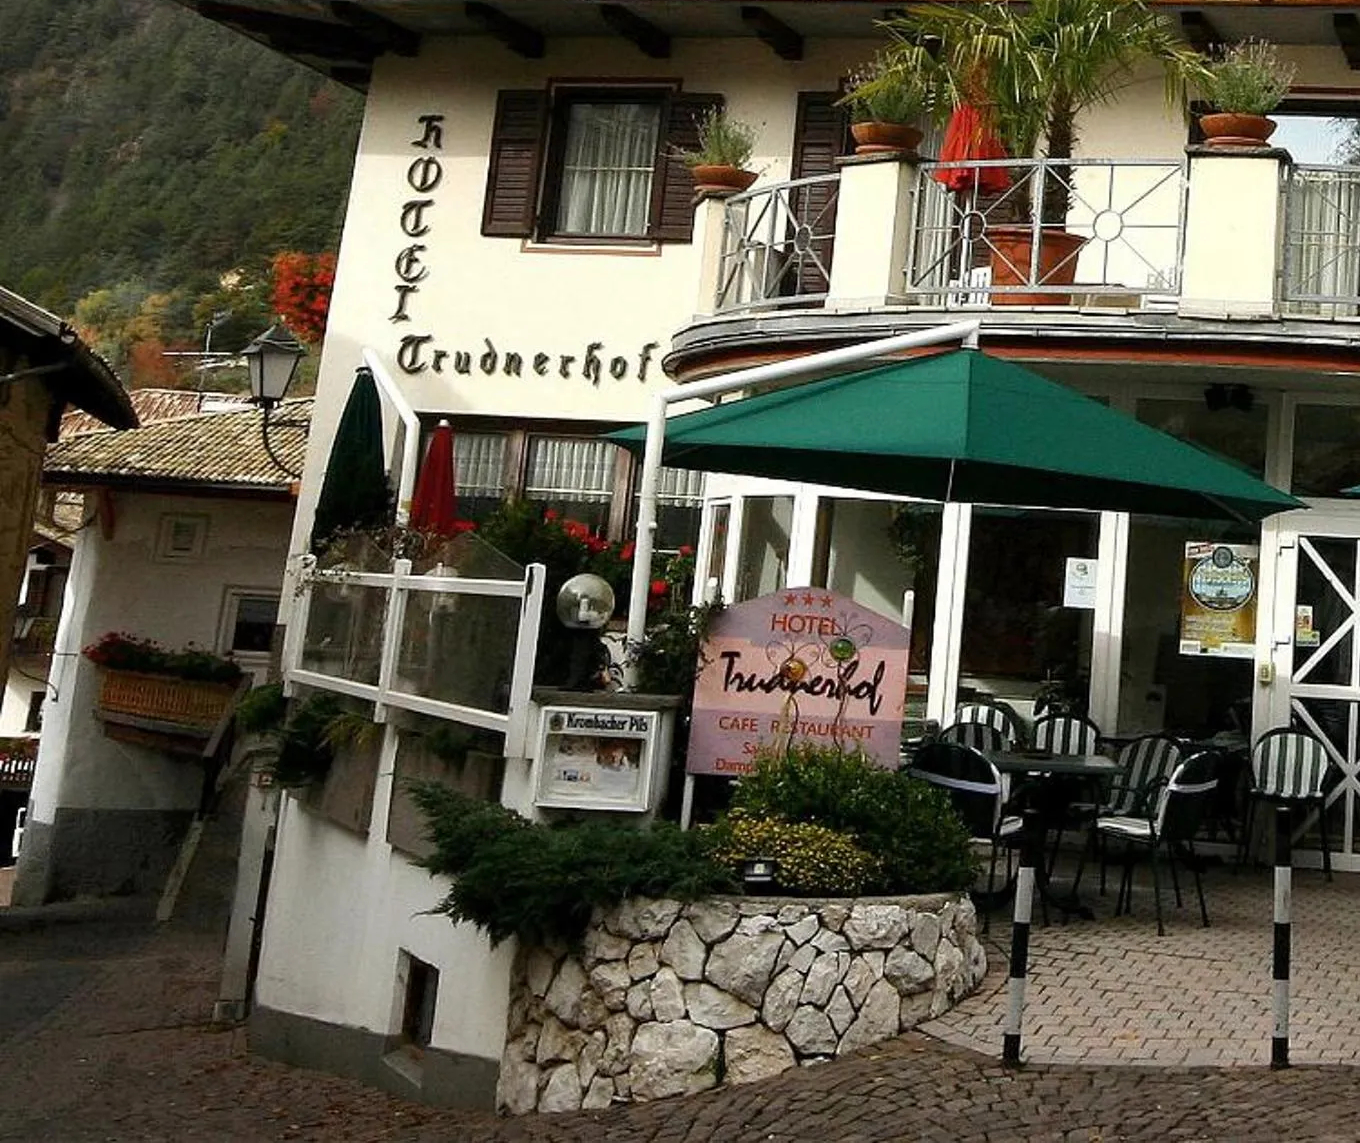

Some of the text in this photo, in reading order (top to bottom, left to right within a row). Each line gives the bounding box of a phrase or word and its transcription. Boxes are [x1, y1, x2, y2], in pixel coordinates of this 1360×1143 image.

[397, 333, 661, 388] Trudnerhof
[770, 613, 840, 636] HOTEL
[719, 716, 759, 733] CAFE
